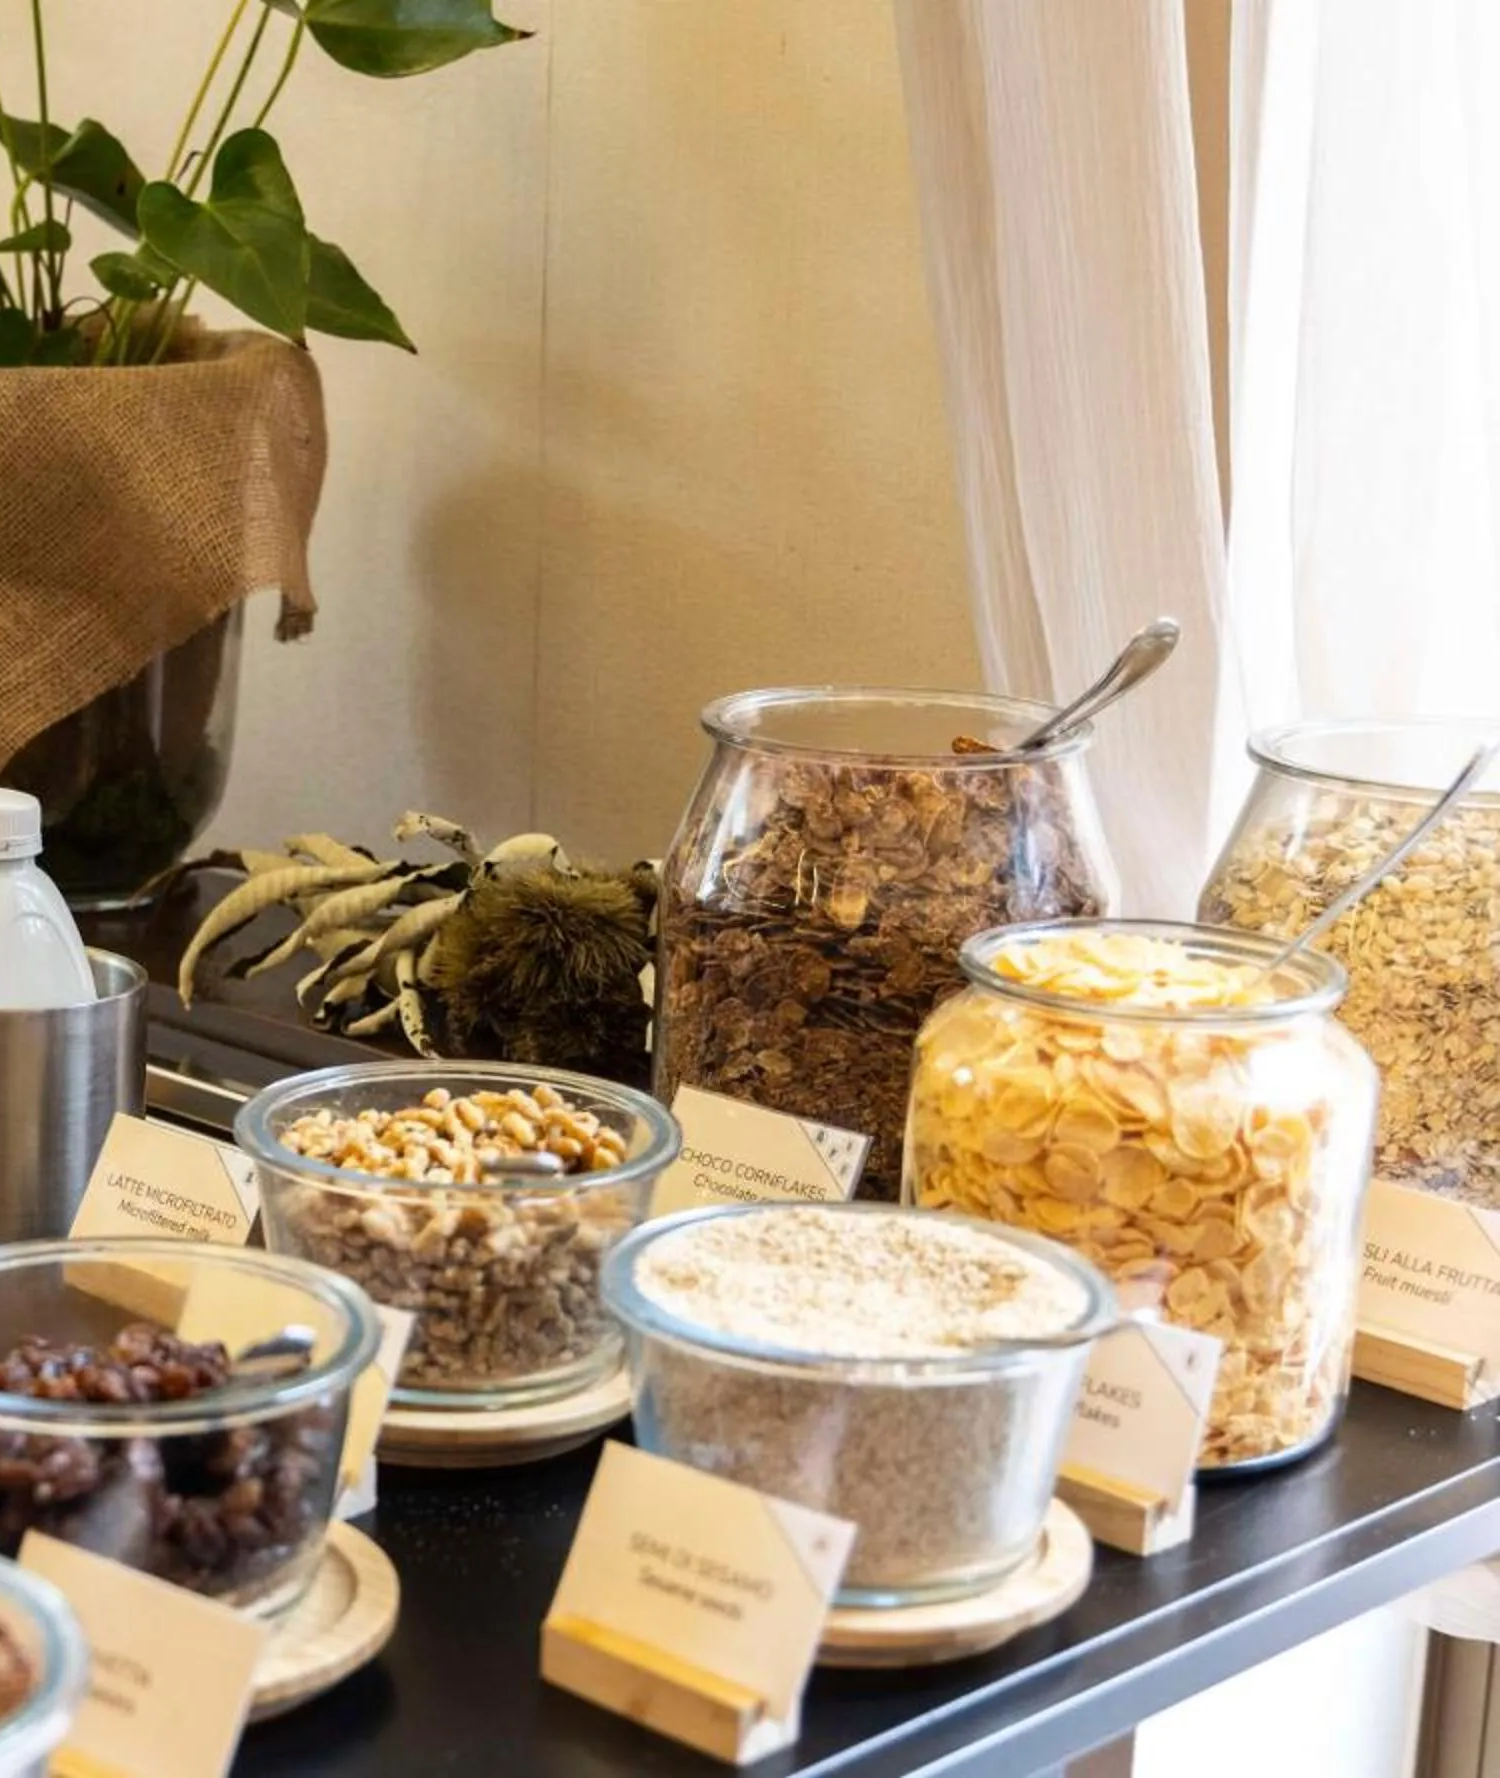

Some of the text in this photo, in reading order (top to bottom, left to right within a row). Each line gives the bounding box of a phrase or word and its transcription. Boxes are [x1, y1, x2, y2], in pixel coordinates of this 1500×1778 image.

[680, 1147, 828, 1201] CHOCO CORNFLAKES
[107, 1173, 237, 1229] LATTE MICROFILTRATO
[1363, 1242, 1388, 1263] SLI
[1390, 1252, 1434, 1276] ALLA
[1363, 1266, 1454, 1305] Fruit muesli
